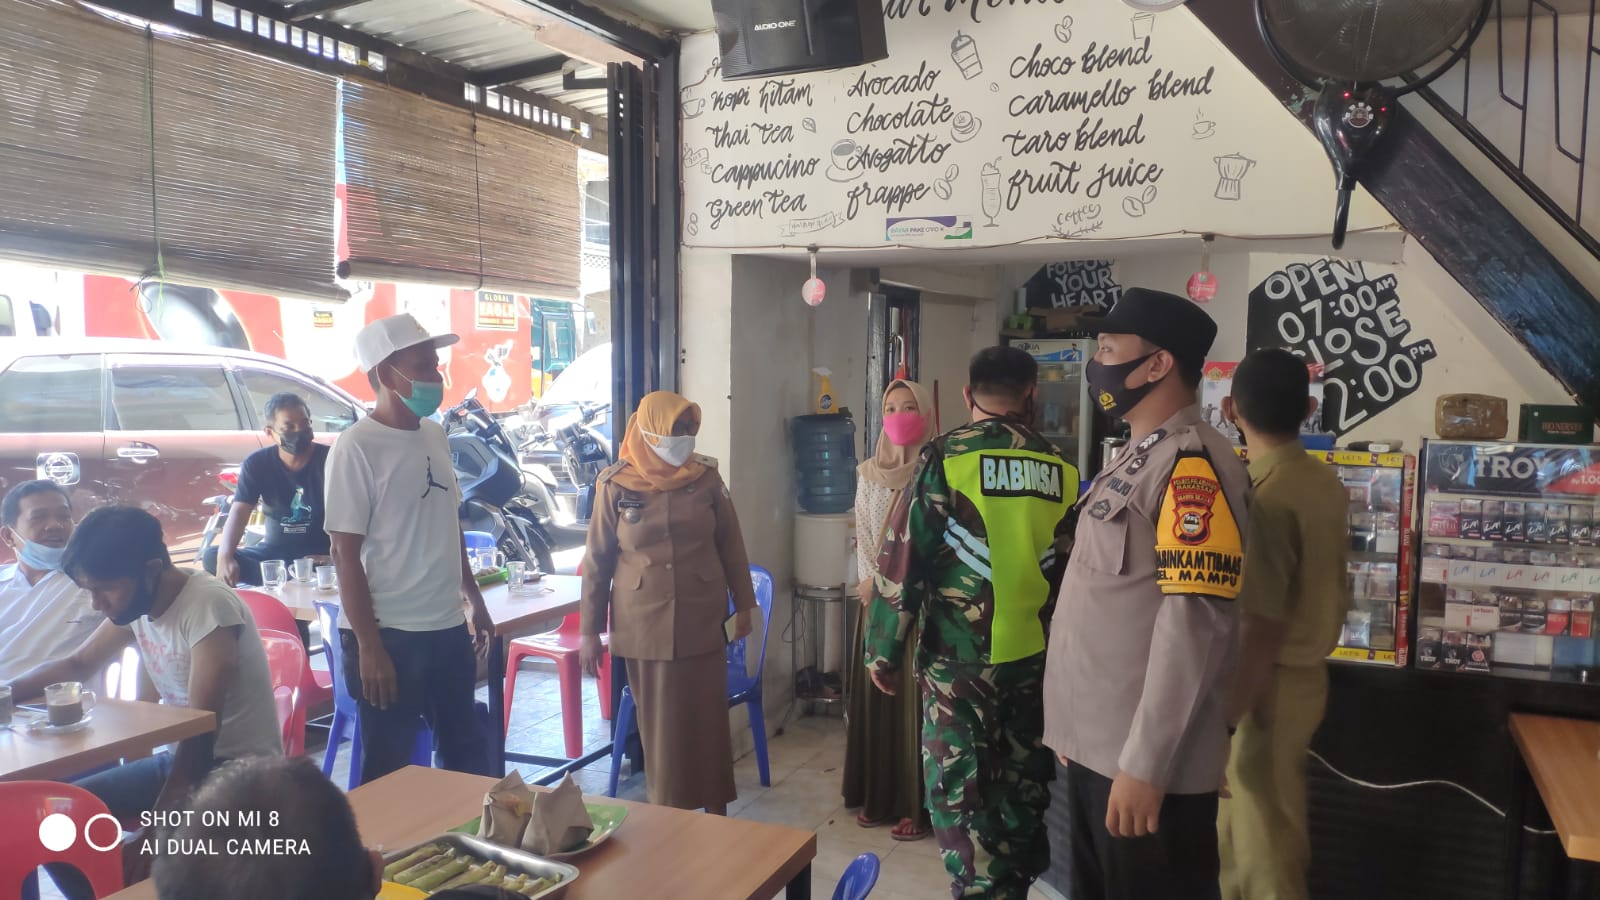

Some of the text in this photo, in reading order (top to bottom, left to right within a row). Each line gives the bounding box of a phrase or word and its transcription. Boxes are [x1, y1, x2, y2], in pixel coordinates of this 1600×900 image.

[1081, 36, 1152, 74] blend
[848, 60, 941, 98] Avocado
[1147, 66, 1214, 101] blend
[751, 123, 795, 145] tea
[1074, 113, 1146, 151] blend
[763, 189, 808, 215] tea
[1051, 286, 1123, 309] HEART
[1055, 267, 1115, 293] YOUR
[1264, 257, 1366, 302] OPEN
[1277, 276, 1396, 344] 07:00 AM
[1290, 299, 1408, 372] LOSE
[1409, 343, 1433, 360] PM
[983, 457, 1062, 498] BABINSA
[1179, 570, 1237, 587] MAMPU
